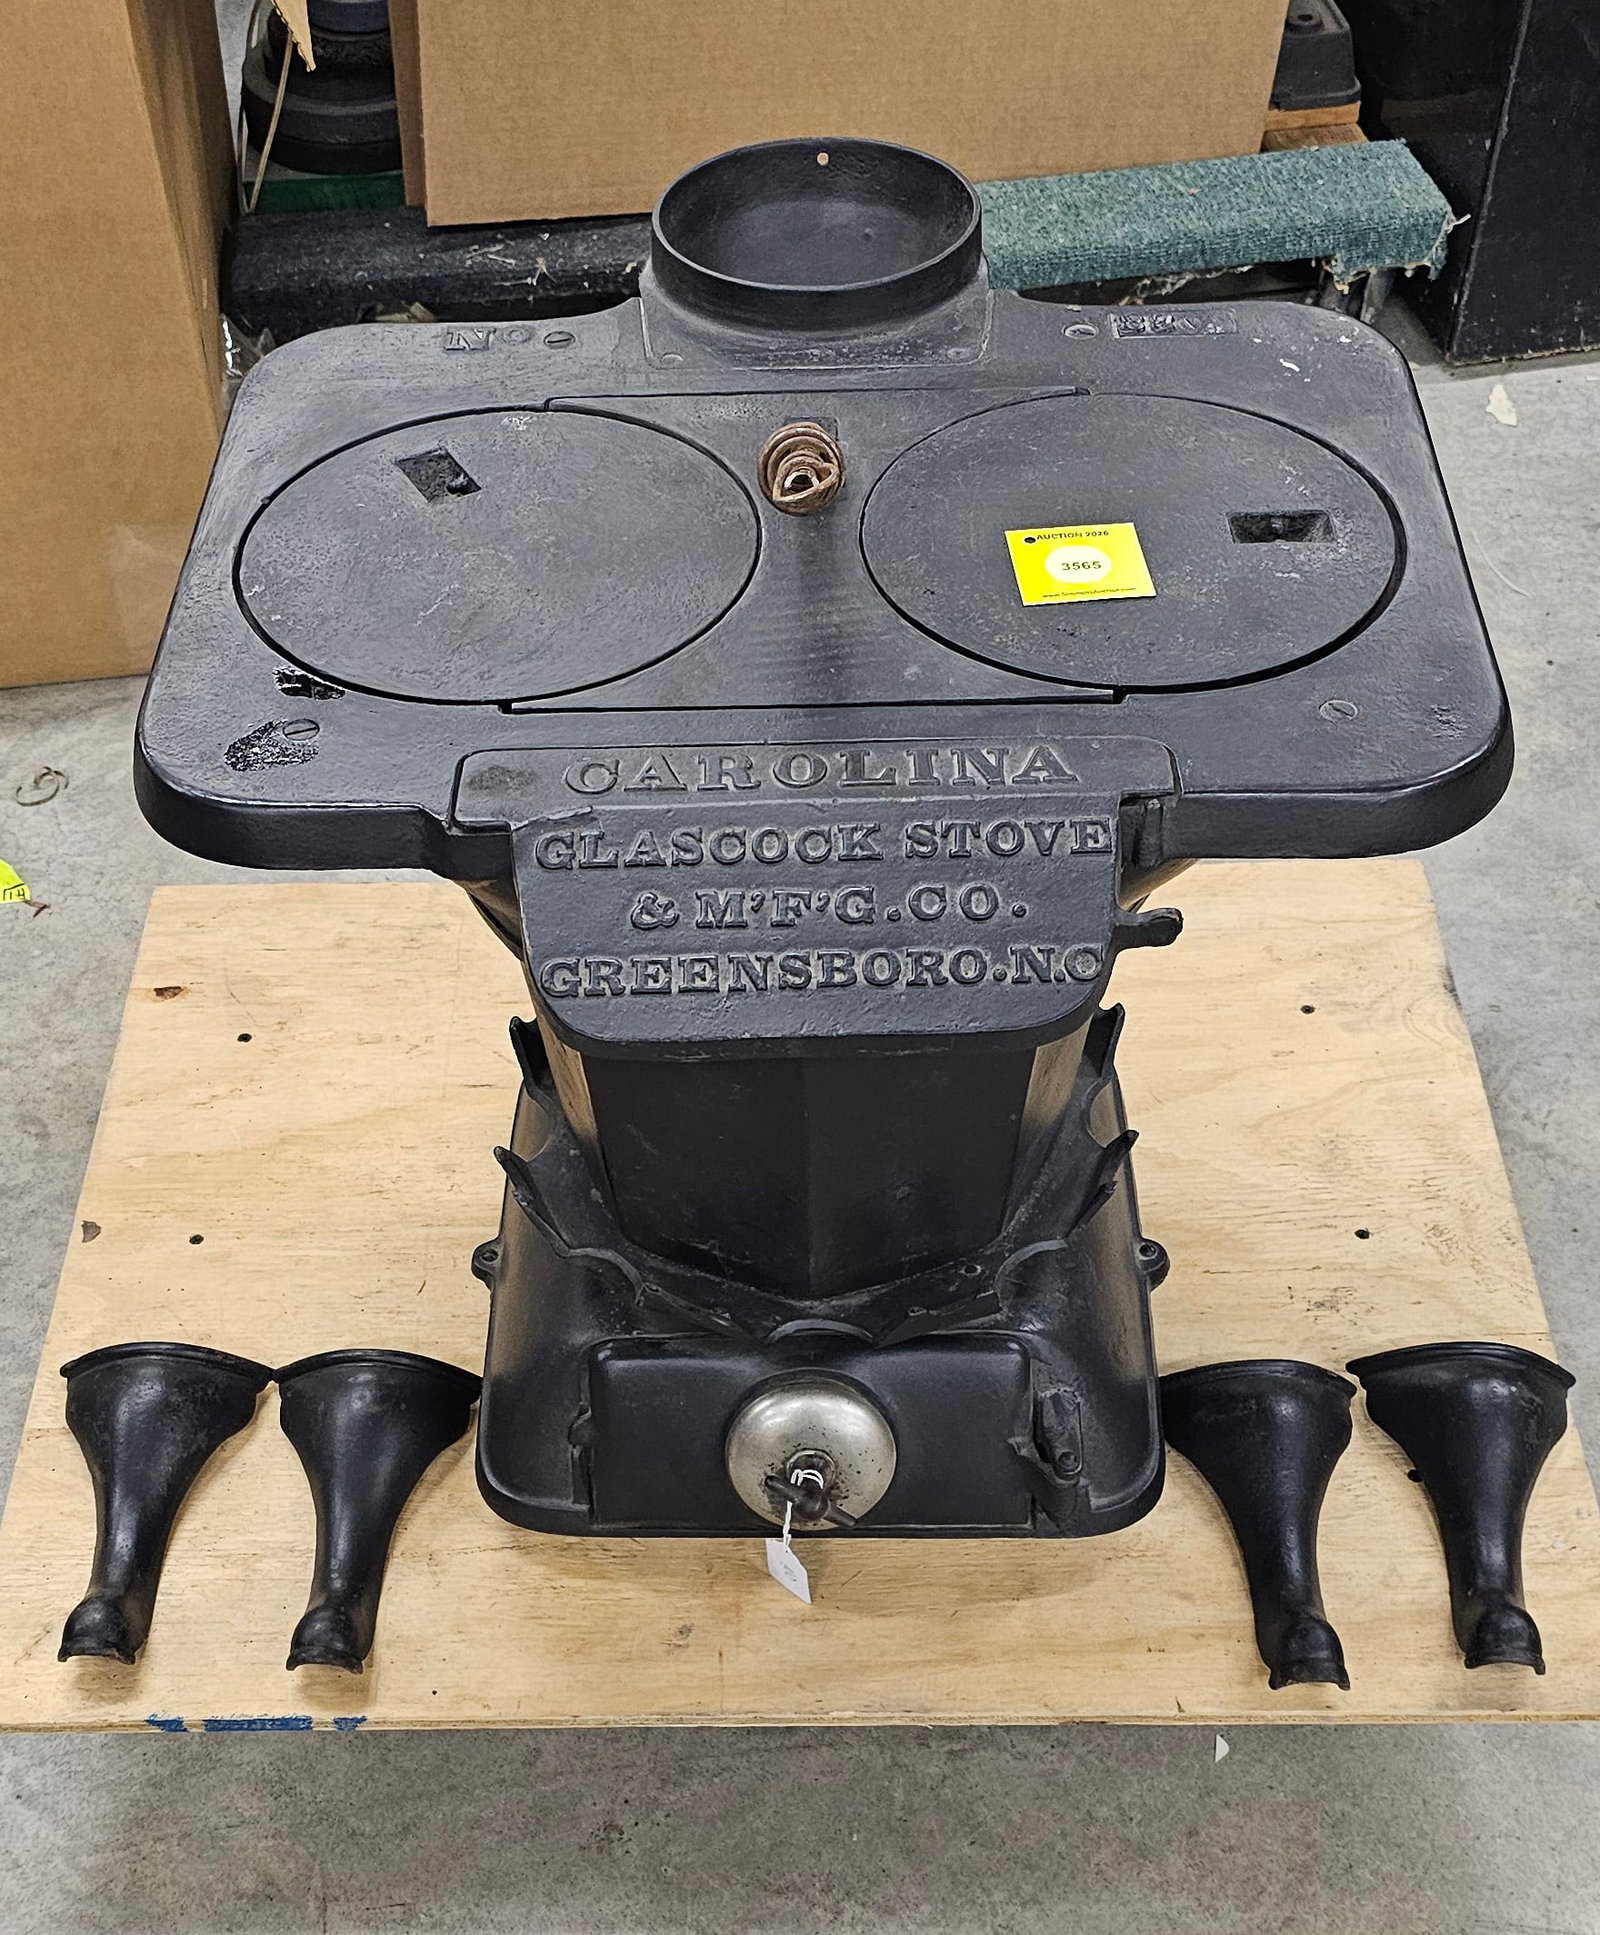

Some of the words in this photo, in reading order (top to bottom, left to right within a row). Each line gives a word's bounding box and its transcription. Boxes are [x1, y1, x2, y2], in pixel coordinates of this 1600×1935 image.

[1036, 532, 1083, 540] AUCTION
[1061, 560, 1102, 571] 3565
[564, 744, 1078, 793] CAROLINA
[534, 823, 882, 870] GLASCOCK
[904, 817, 1113, 858] STOVE
[630, 892, 680, 930] &
